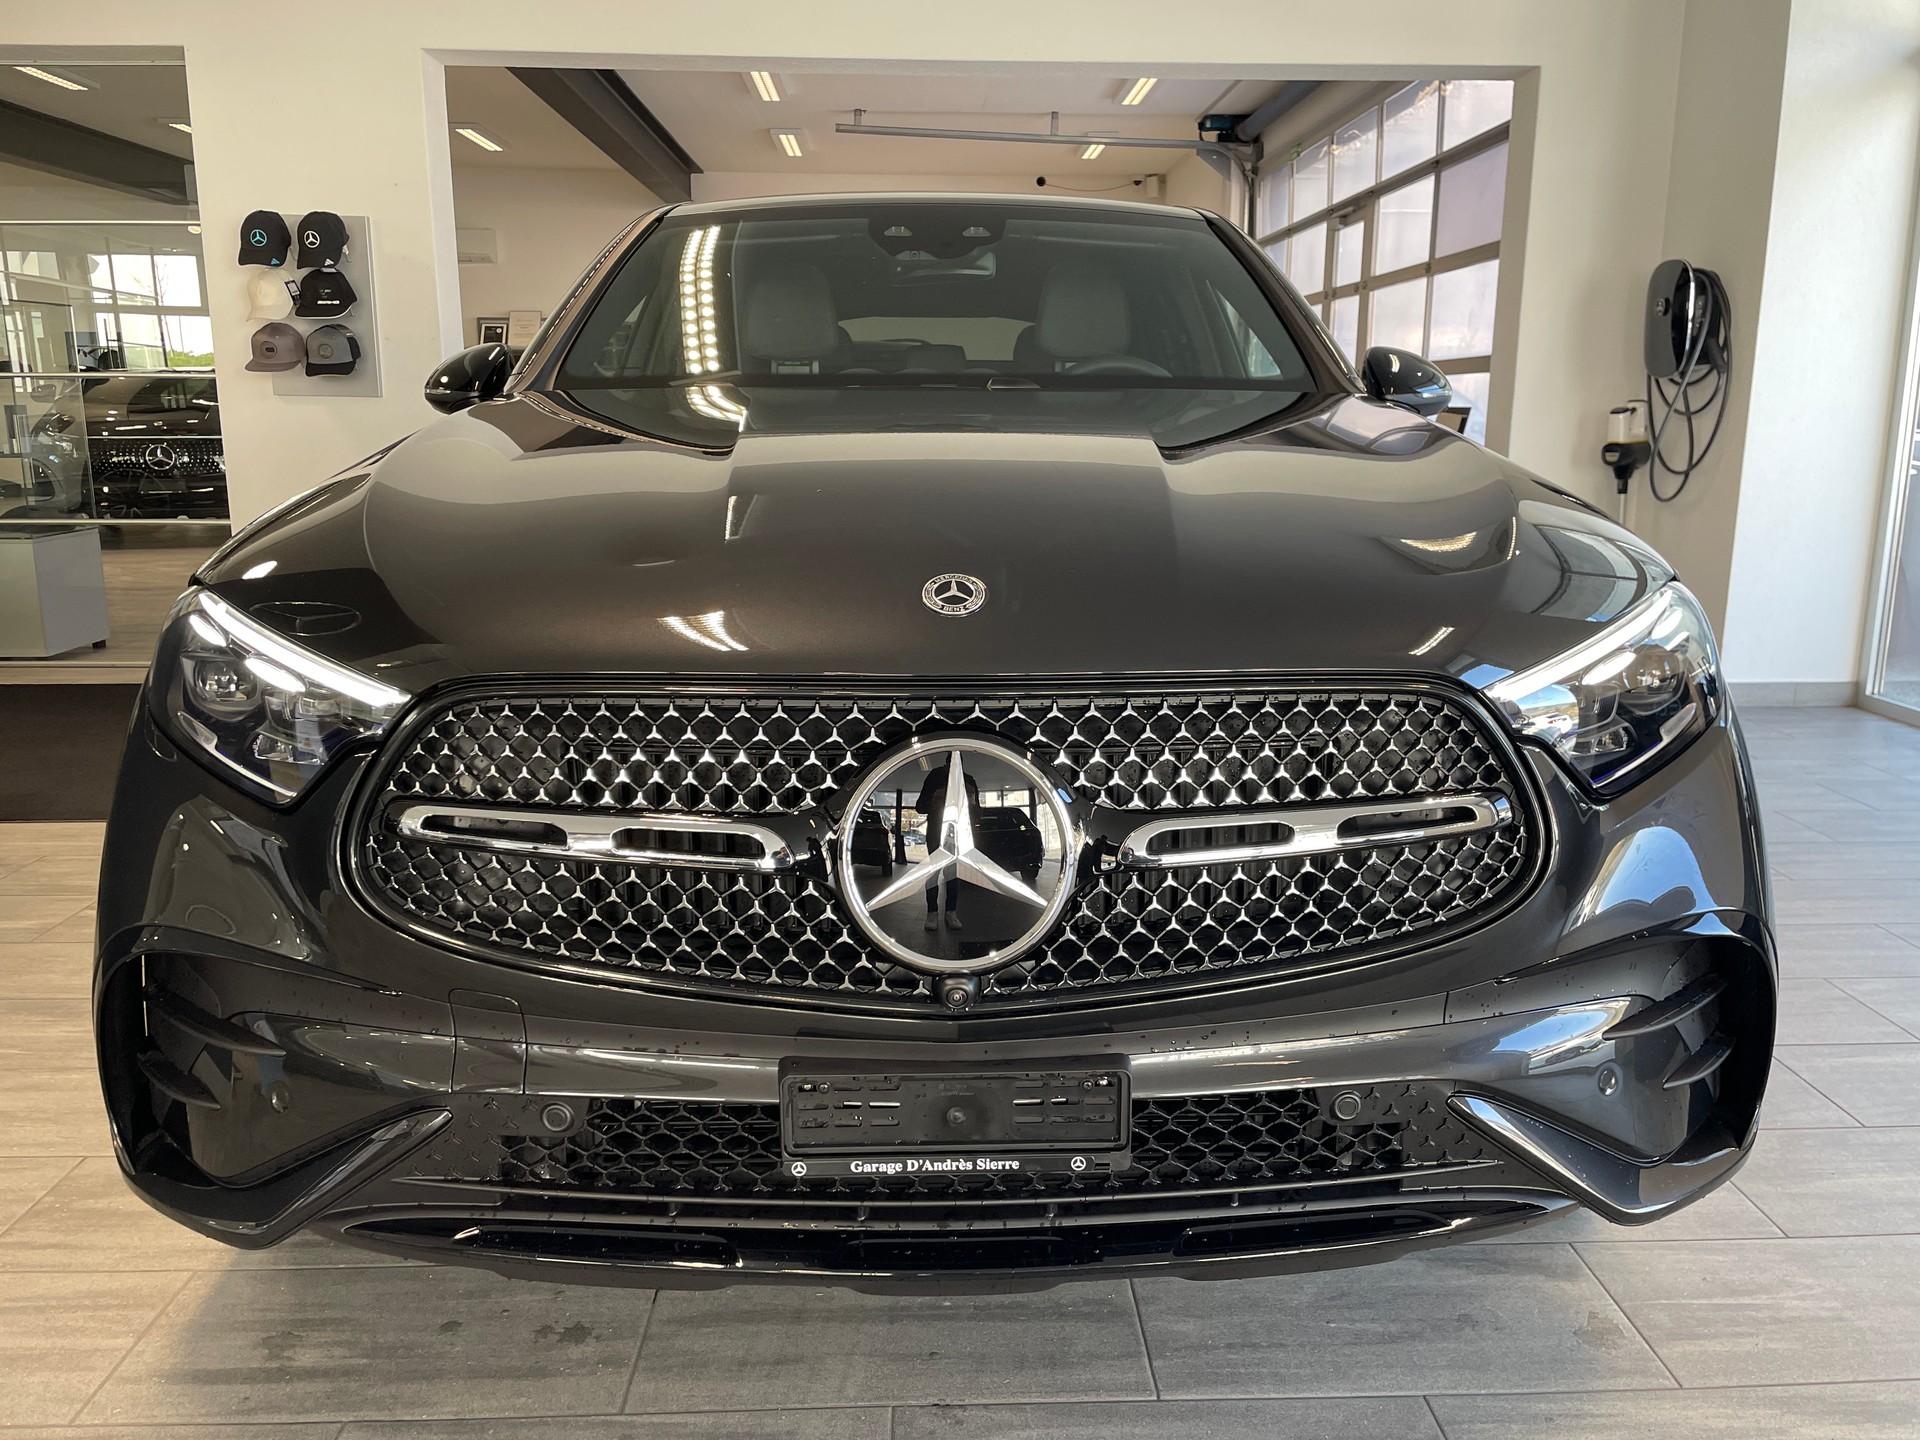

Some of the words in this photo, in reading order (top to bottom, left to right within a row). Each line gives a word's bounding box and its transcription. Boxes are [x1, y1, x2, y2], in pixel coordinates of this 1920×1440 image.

[850, 1160, 903, 1174] Garage
[906, 1159, 973, 1171] D’Andrès
[976, 1158, 1020, 1170] Sierre
